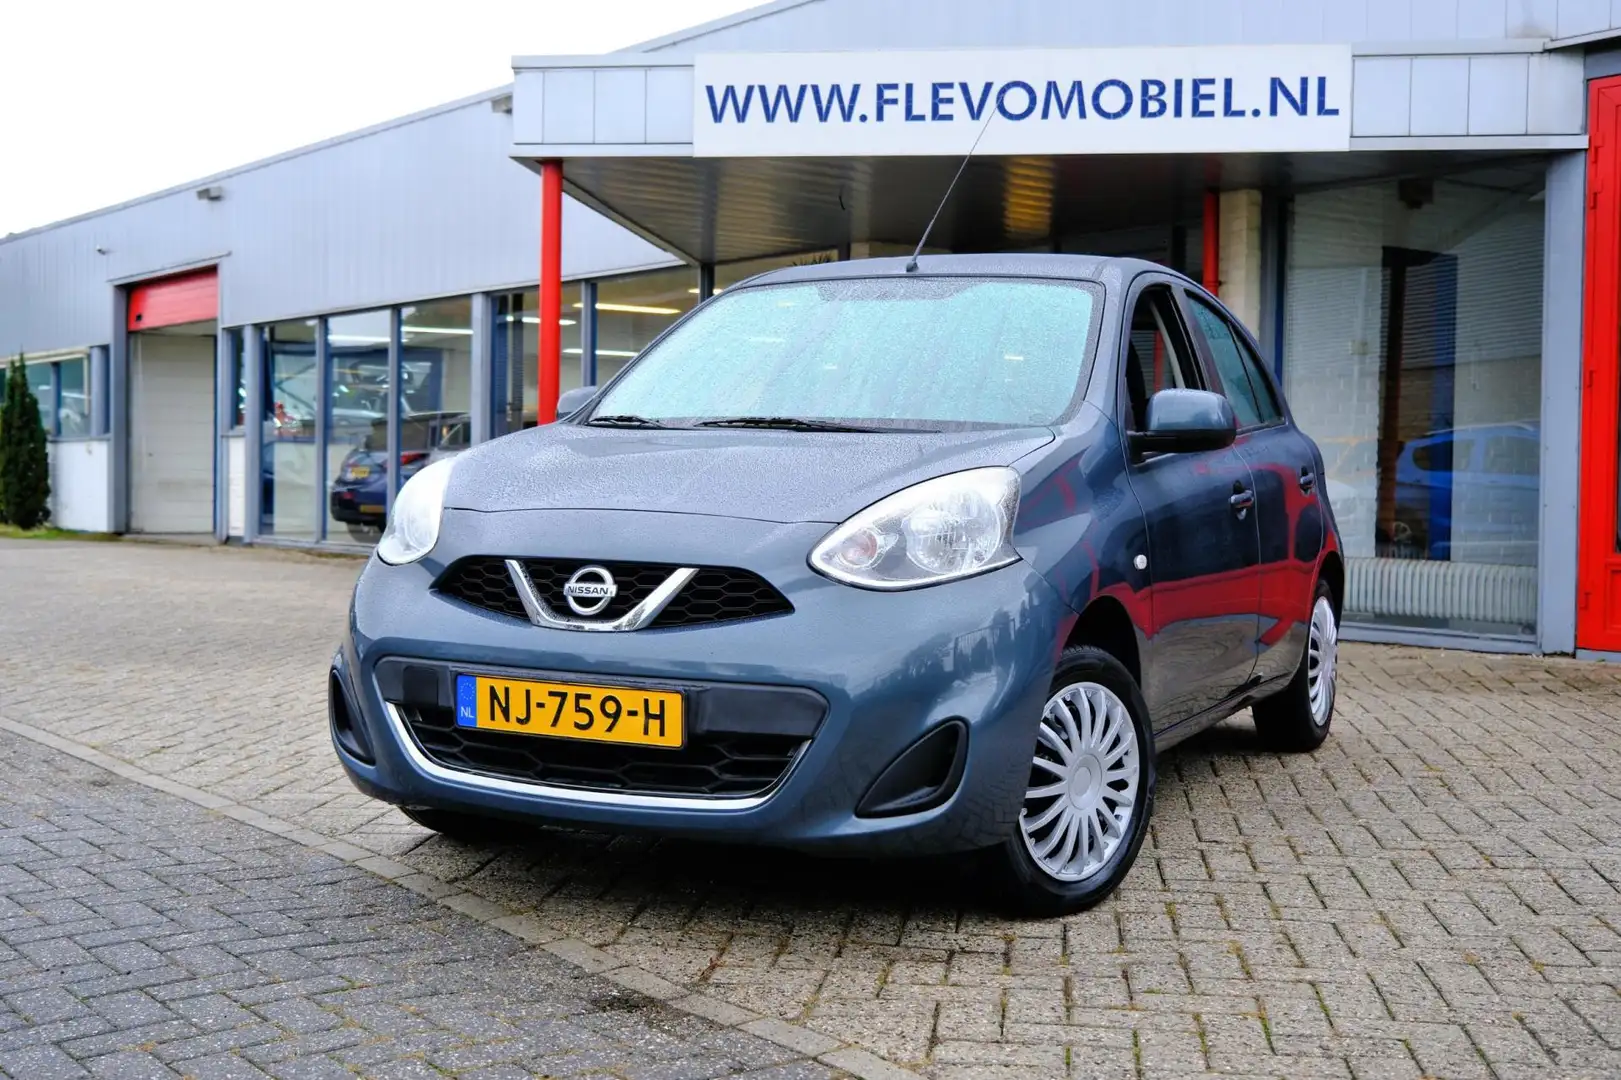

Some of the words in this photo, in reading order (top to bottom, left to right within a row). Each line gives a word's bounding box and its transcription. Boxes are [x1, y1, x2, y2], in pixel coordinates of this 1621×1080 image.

[705, 76, 1340, 124] WWW.FLEVOMOBIEL.NL
[567, 585, 609, 595] NISSAN
[460, 706, 474, 719] NL
[489, 685, 666, 737] NJ-759-H
